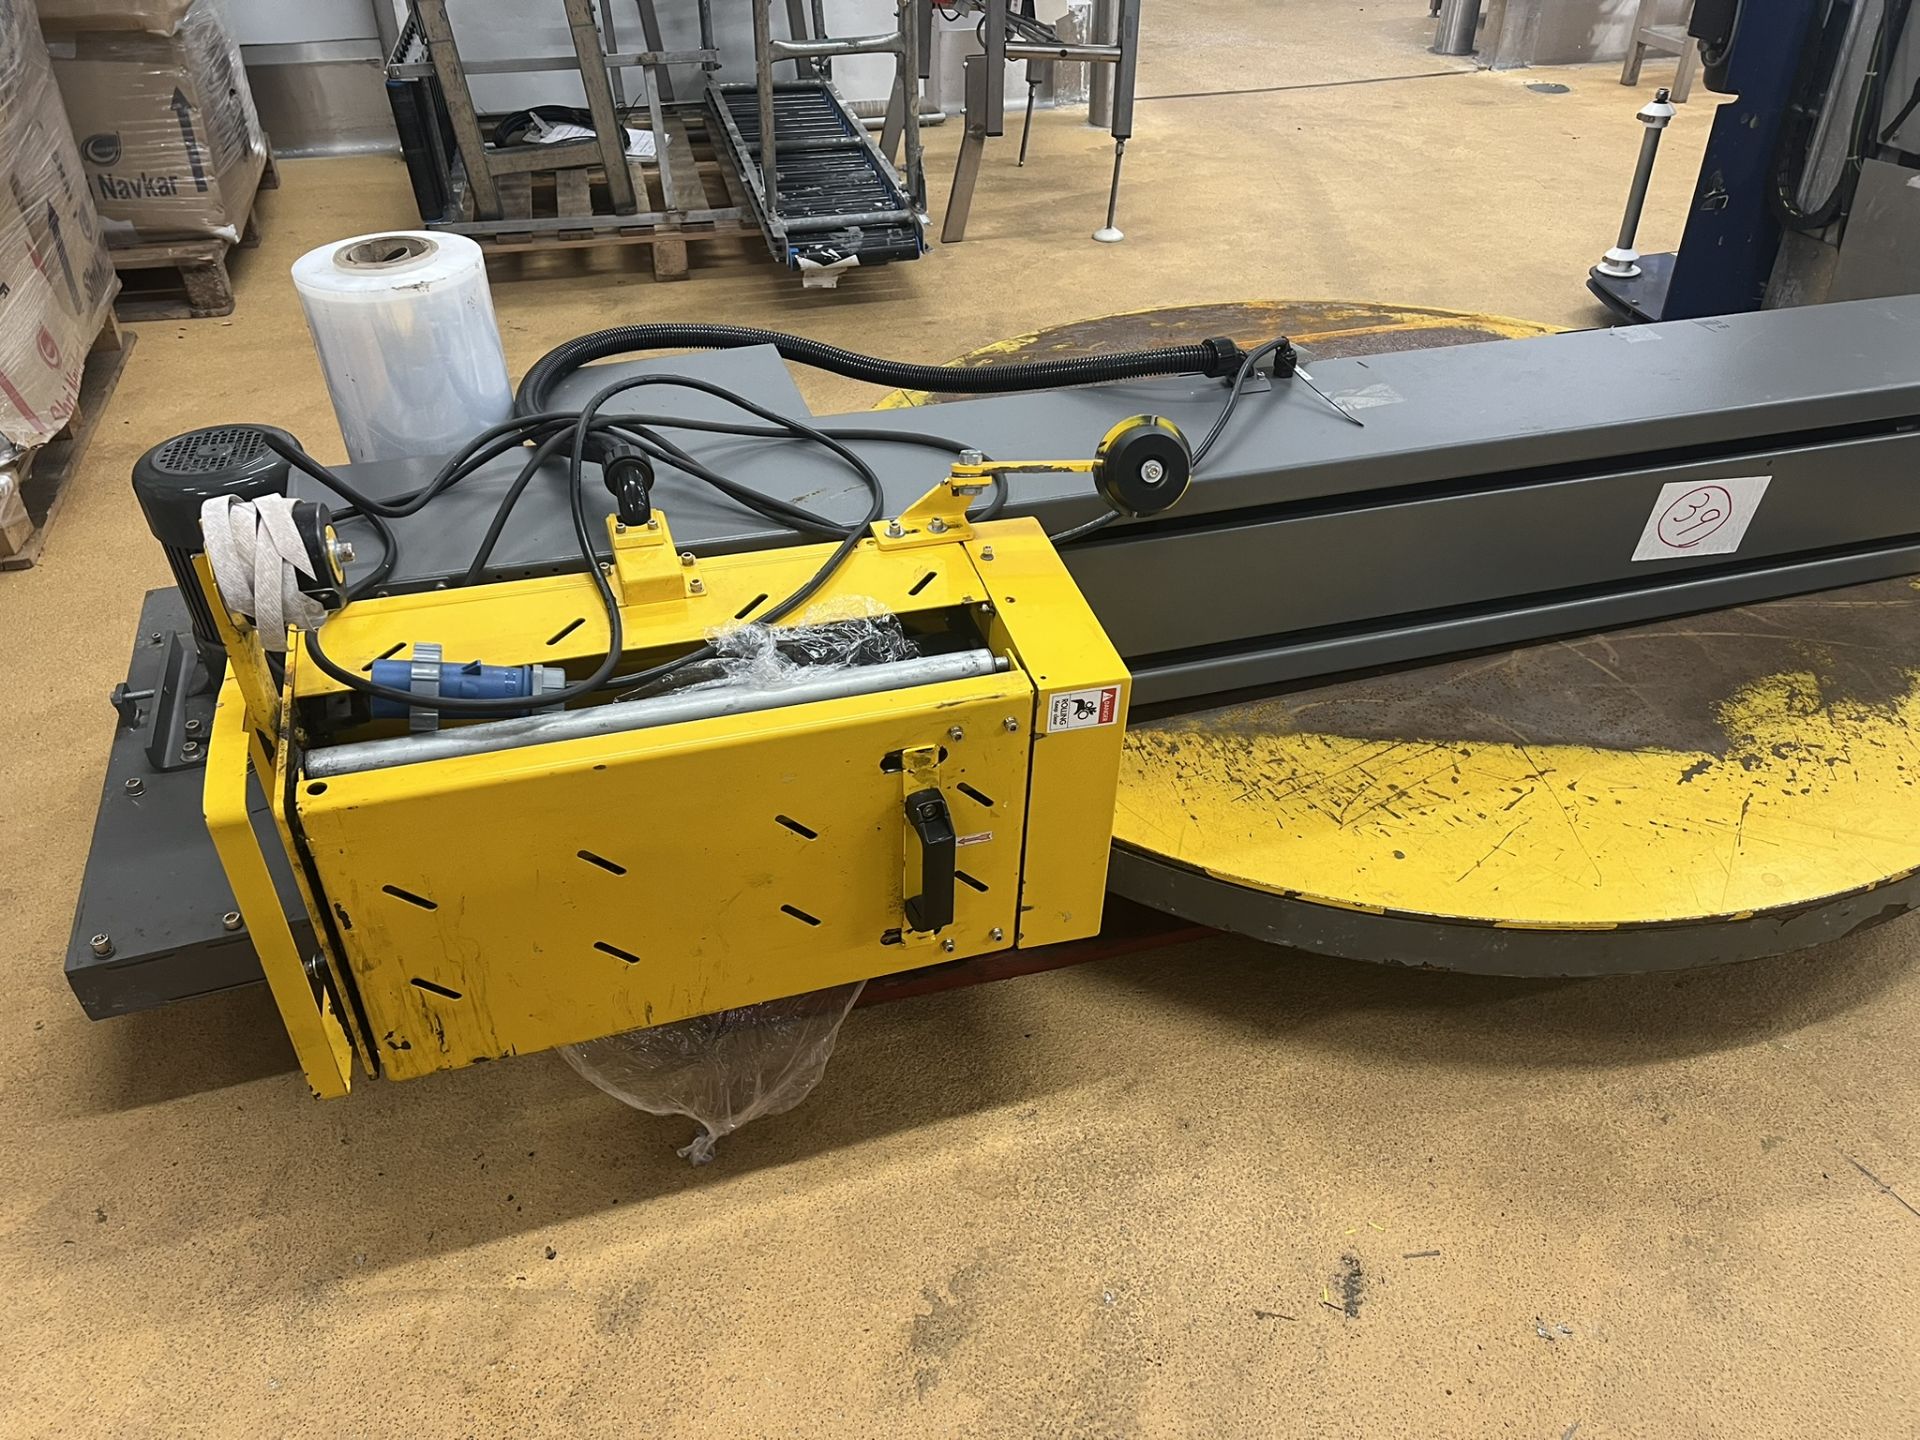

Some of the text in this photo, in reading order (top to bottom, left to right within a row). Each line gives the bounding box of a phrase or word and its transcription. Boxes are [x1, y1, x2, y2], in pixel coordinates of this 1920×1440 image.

[97, 172, 178, 201] Navkar
[1059, 698, 1069, 726] ROLLING
[1102, 700, 1111, 722] DANGER
